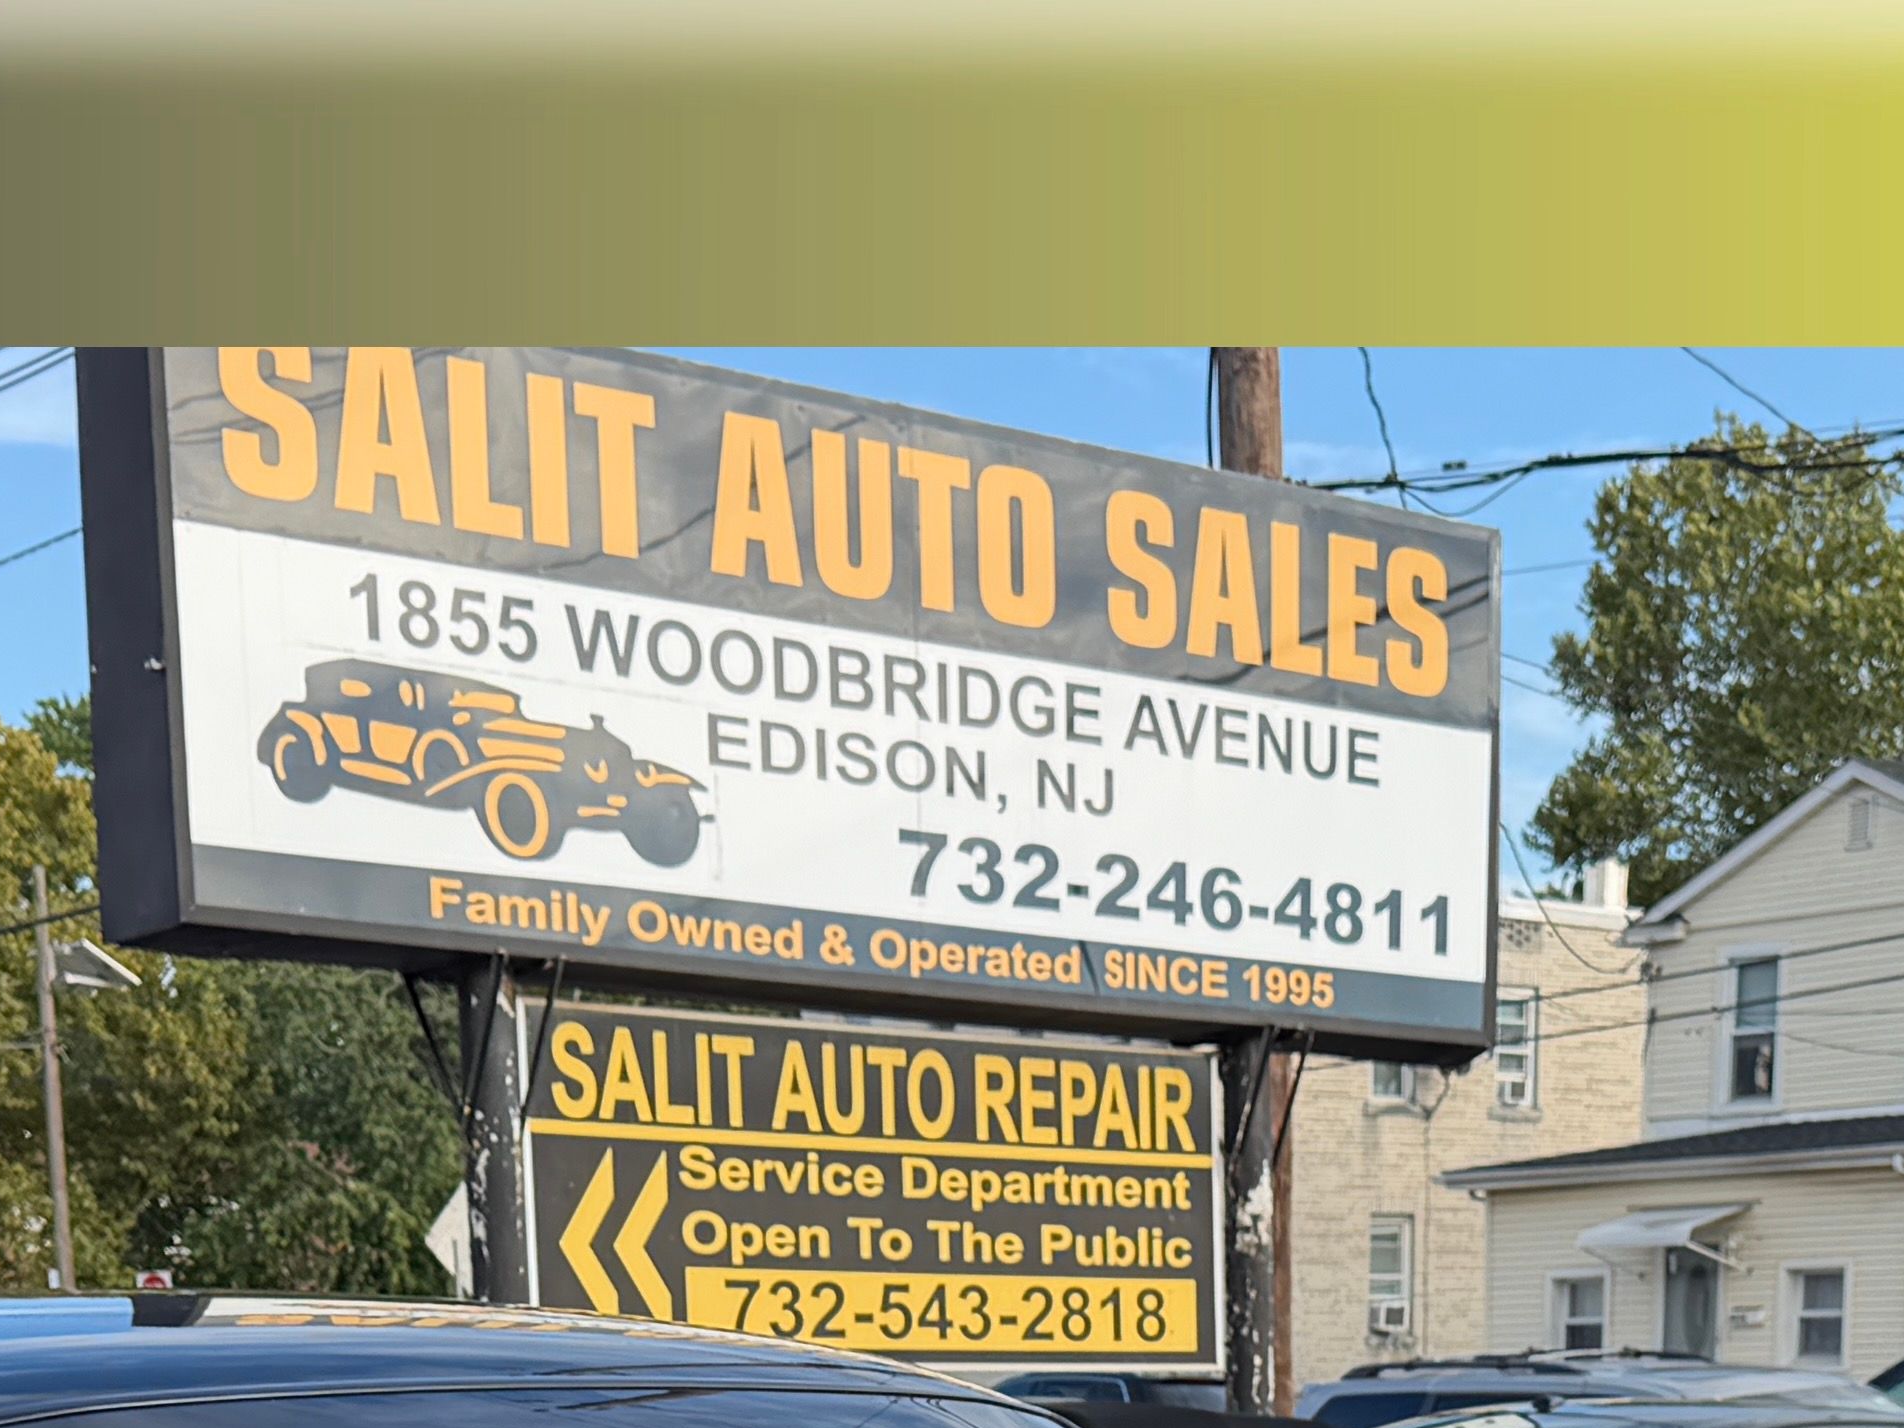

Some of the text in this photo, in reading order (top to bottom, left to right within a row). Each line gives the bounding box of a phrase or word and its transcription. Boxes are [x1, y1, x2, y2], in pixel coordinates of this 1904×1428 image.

[218, 346, 1449, 697] SALIT AUTO SALES
[347, 572, 1381, 787] 1855 WOODBRIDGE AVENUE
[706, 713, 1116, 819] EDISON, NJ
[431, 877, 1335, 1008] Family Owned & Operated SINCE 1995
[897, 828, 1449, 956] 732-246-4811
[551, 1021, 1196, 1153] SALIT AUTO REPAIR
[680, 1144, 1191, 1212] Service Department
[683, 1211, 1192, 1269] Open To The Public
[724, 1279, 1166, 1343] 732-543-2818
